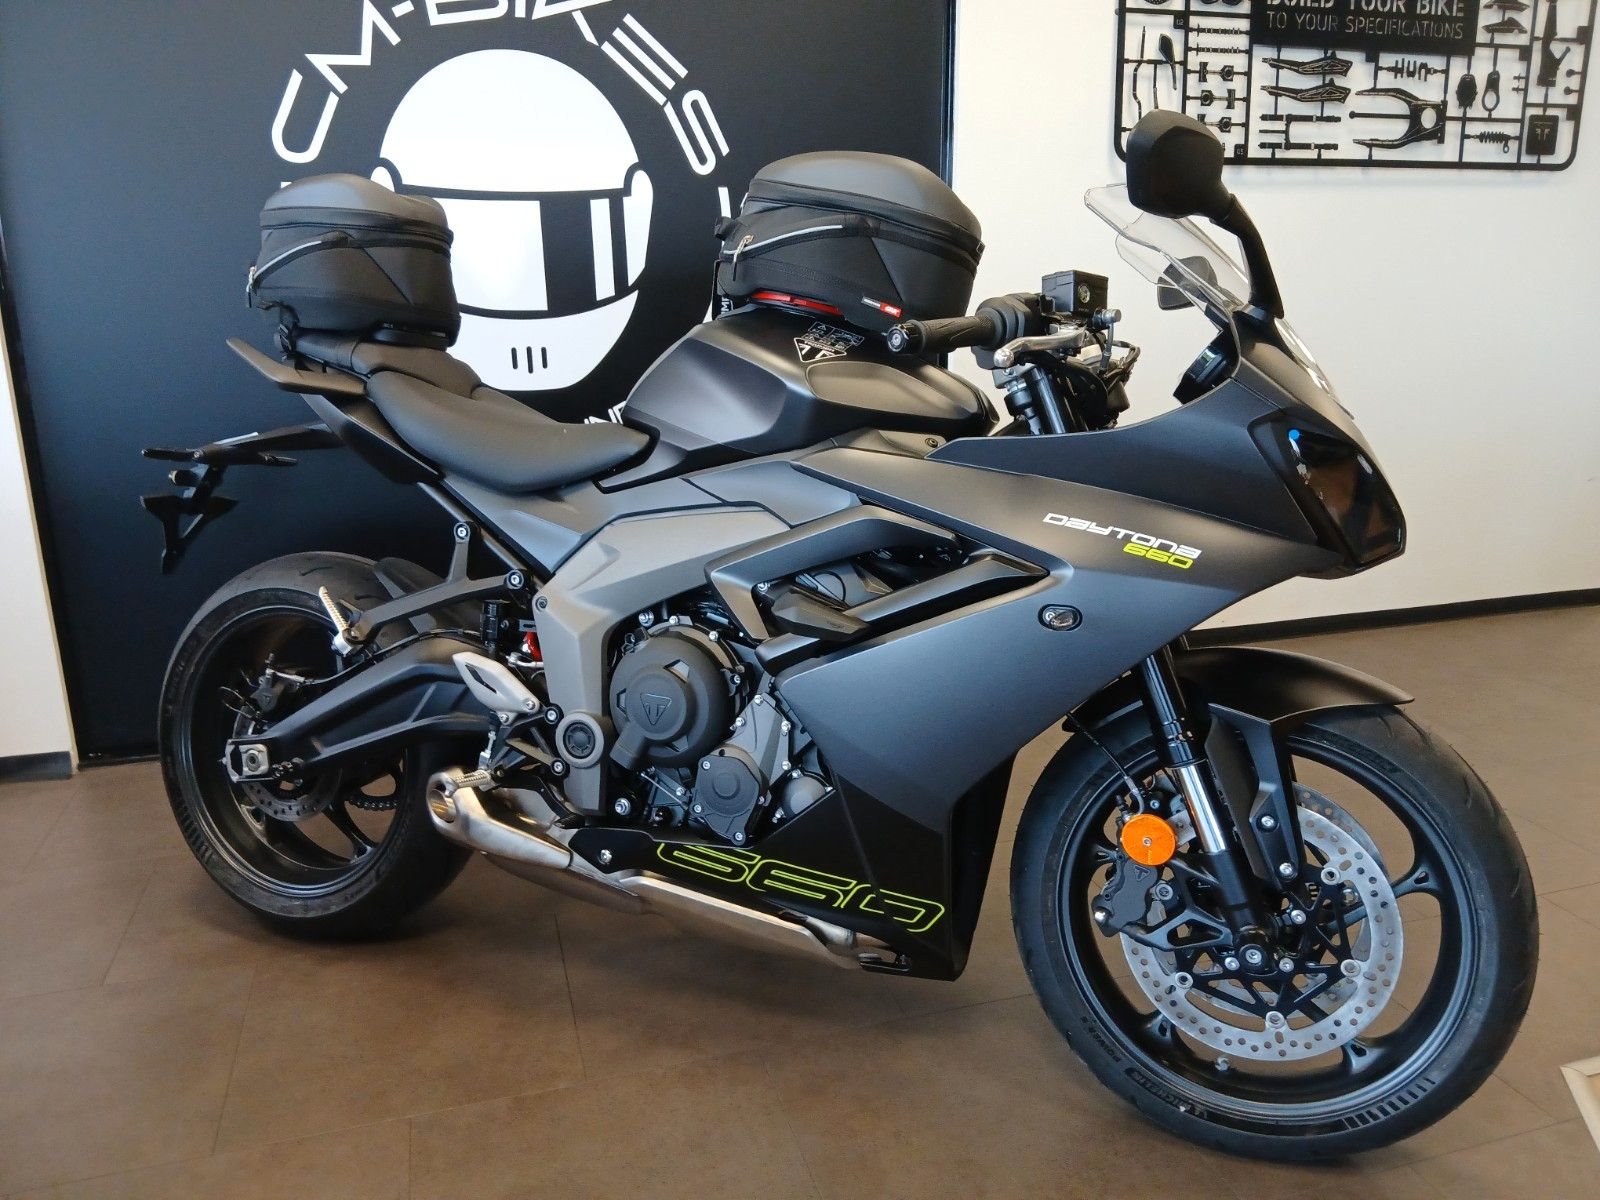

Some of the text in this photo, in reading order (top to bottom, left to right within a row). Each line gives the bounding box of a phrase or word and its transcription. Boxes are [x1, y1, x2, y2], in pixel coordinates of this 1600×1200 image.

[1416, 0, 1465, 17] BIKE
[1267, 11, 1464, 39] TO YOUR SPECIFICATIONS
[1123, 542, 1194, 569] 660
[657, 842, 945, 932] 660
